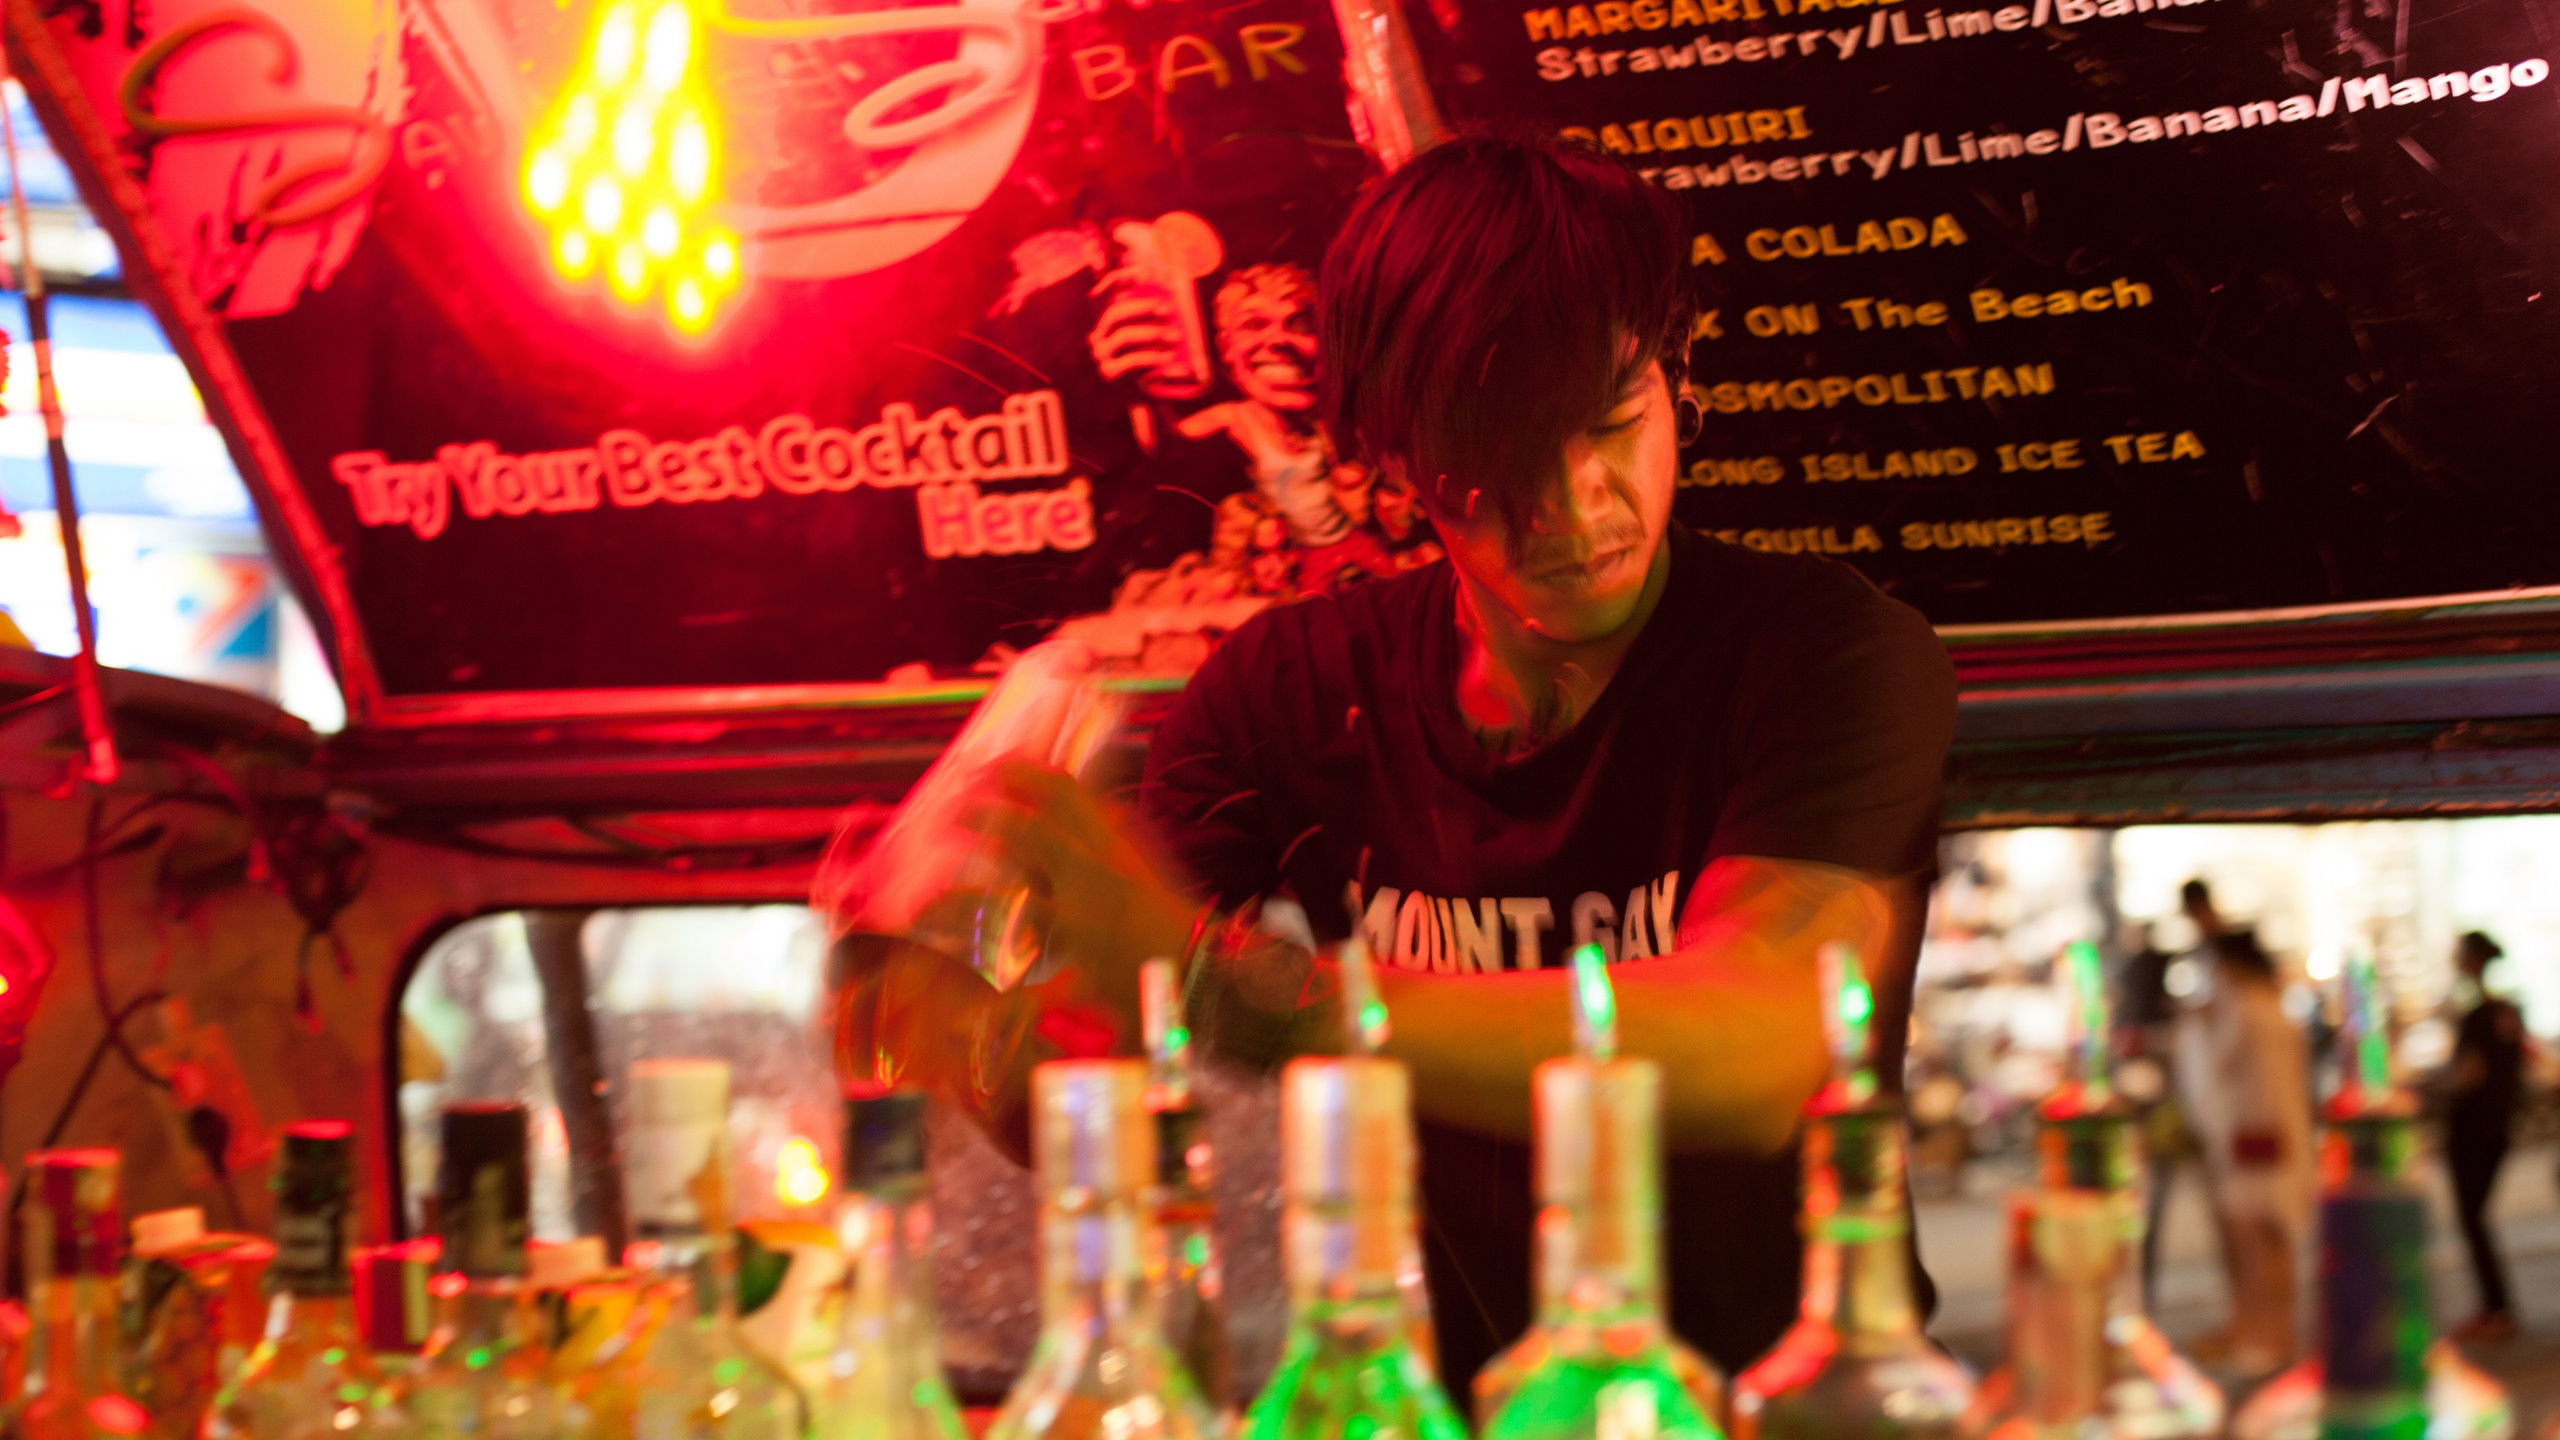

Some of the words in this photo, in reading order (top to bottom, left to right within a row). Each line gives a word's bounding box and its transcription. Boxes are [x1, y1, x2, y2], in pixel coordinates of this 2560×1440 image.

[1071, 22, 1308, 101] BAR
[1535, 0, 2222, 82] Strawberry/Lime/Ba
[1637, 58, 2550, 191] rawberry/Lime/Banana/Mango
[1745, 213, 1967, 262] COLADA
[1743, 302, 1821, 339] ON
[1839, 297, 1949, 332] The
[1969, 277, 2153, 323] Beach
[1692, 362, 2056, 415] OSMOPOLITAN
[331, 450, 450, 540] Try
[436, 439, 600, 519] Your
[598, 425, 766, 509] Best
[757, 388, 1070, 495] Cocktail
[1800, 446, 1978, 484] ISLAND
[1995, 438, 2086, 474] ICE
[2103, 430, 2206, 466] TEA
[916, 480, 1095, 560] Here
[1697, 523, 1884, 555] QUILA
[1900, 511, 2116, 551] SUNRISE
[1345, 879, 1555, 975] MOUNT
[1571, 869, 1679, 964] GAY
